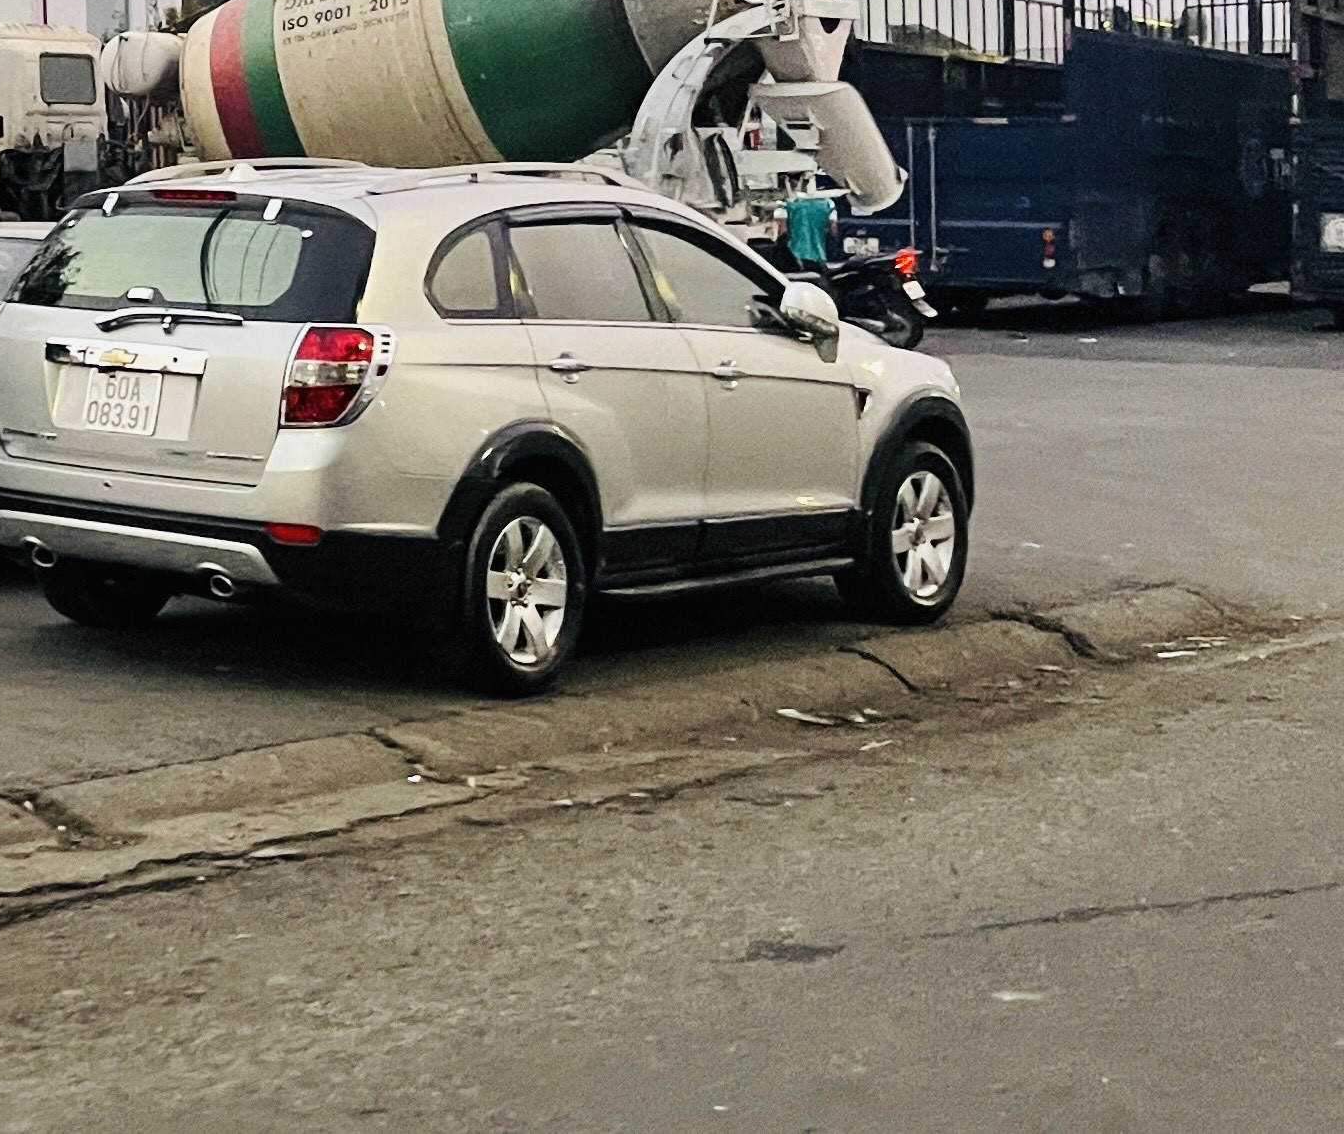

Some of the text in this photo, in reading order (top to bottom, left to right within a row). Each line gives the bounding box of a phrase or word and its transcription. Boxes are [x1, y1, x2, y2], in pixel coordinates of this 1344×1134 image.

[282, 15, 309, 31] ISO
[314, 6, 351, 24] 9001
[104, 374, 141, 403] 60A
[85, 400, 151, 432] 083.91
